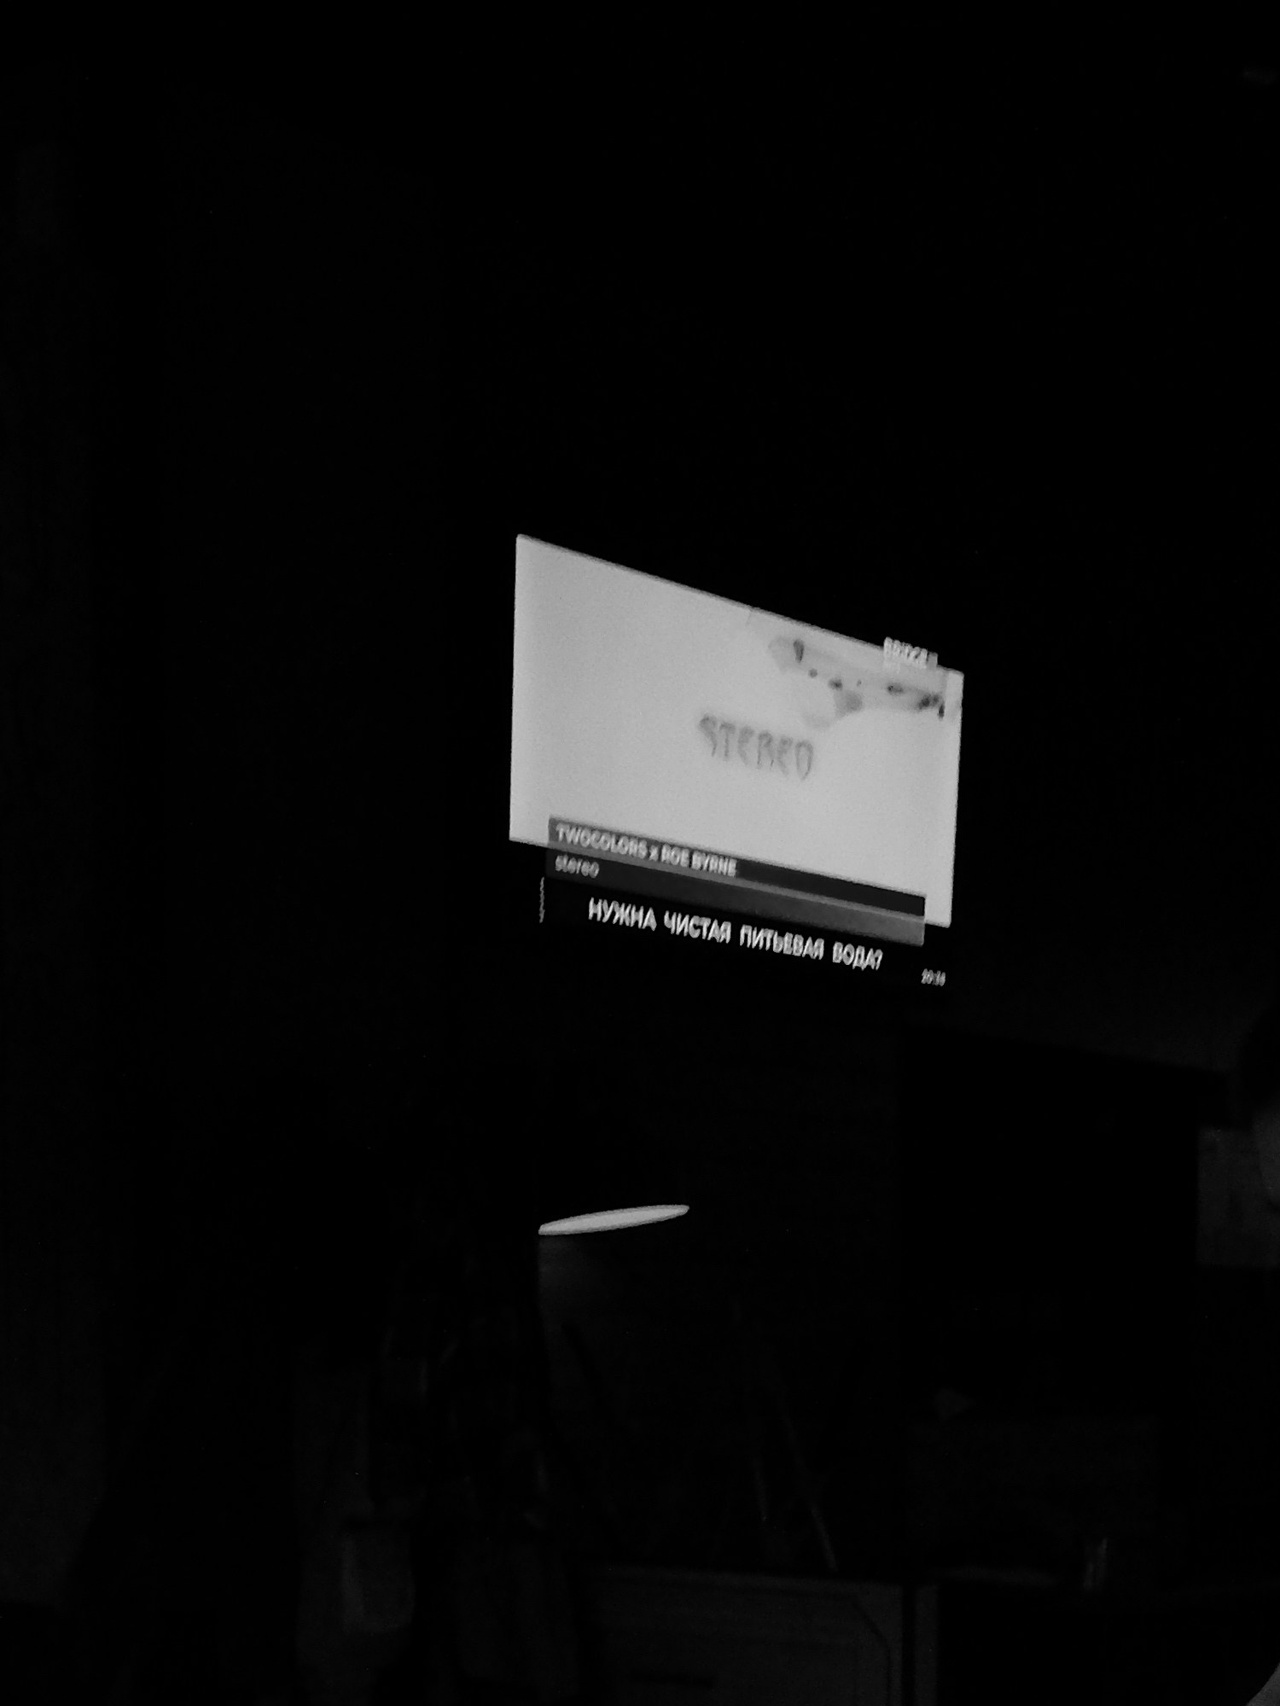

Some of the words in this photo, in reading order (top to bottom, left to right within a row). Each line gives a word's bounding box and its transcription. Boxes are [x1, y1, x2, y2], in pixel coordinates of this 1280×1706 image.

[699, 715, 814, 779] STEREO
[555, 822, 649, 860] TWOCOLORS
[555, 854, 600, 879] stereo
[589, 897, 657, 931] НУЖНА
[664, 911, 731, 943] ЧИСТАЯ
[740, 925, 824, 960] ПИТЬЕВАЯ
[832, 941, 883, 970] ВОДА?
